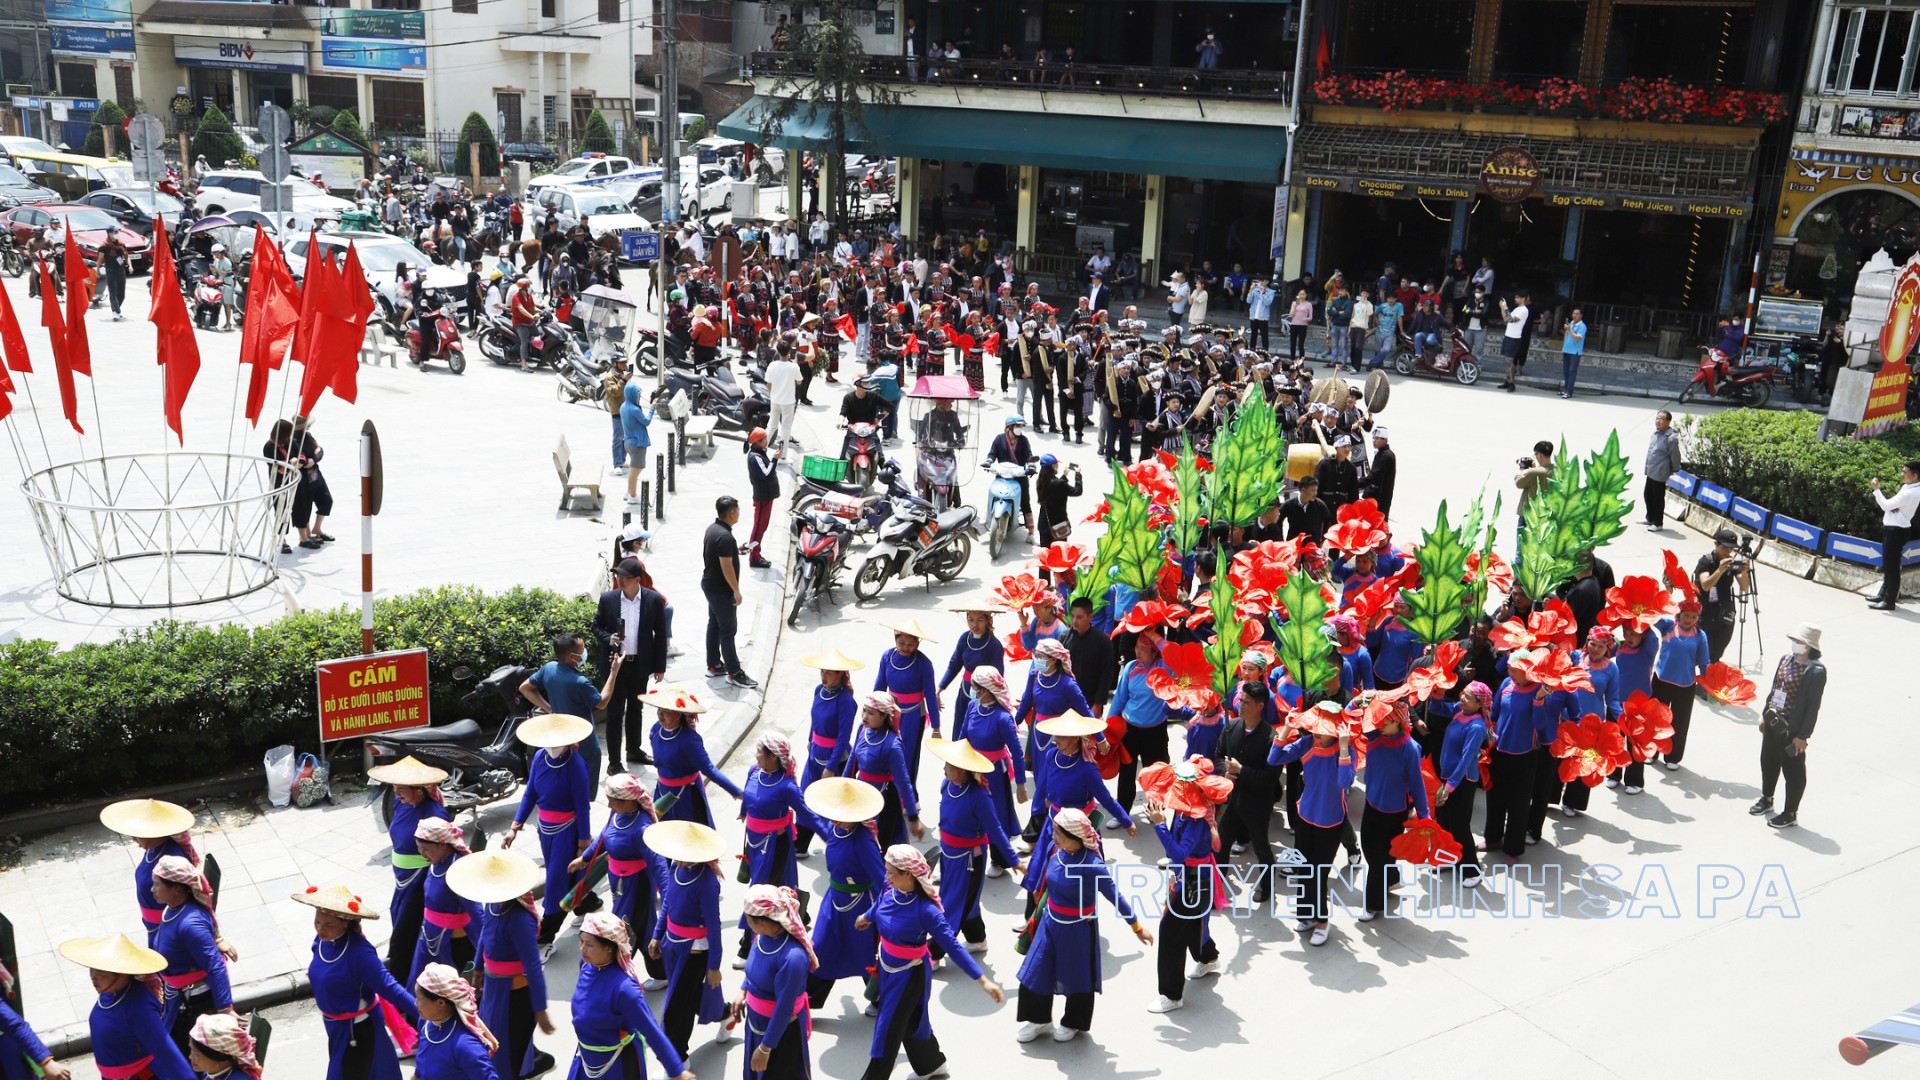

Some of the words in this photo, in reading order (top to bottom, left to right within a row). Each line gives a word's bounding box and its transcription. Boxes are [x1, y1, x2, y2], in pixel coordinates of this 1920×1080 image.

[219, 43, 243, 58] BIDV
[1482, 162, 1538, 178] Anise
[1306, 177, 1339, 189] Bakery
[1358, 180, 1405, 191] Chocolatier
[1789, 182, 1815, 192] Pizza
[1368, 189, 1394, 198] Cacao
[1445, 188, 1469, 198] Drinks
[1552, 195, 1570, 206] Egg
[1573, 196, 1605, 207] Coffee
[1622, 199, 1644, 210] Fresh
[1647, 201, 1674, 212] Juices
[1688, 204, 1721, 214] Herbal
[1725, 206, 1744, 216] Tea
[632, 246, 645, 256] XUÂN
[349, 662, 397, 688] CẤM
[338, 697, 349, 710] XE
[351, 691, 370, 707] DƯỚI
[372, 689, 393, 704] LÒNG
[395, 685, 423, 701] ĐƯỜNG
[331, 717, 341, 731] VÀ
[344, 714, 366, 730] HÀNH
[368, 711, 392, 726] LANG,
